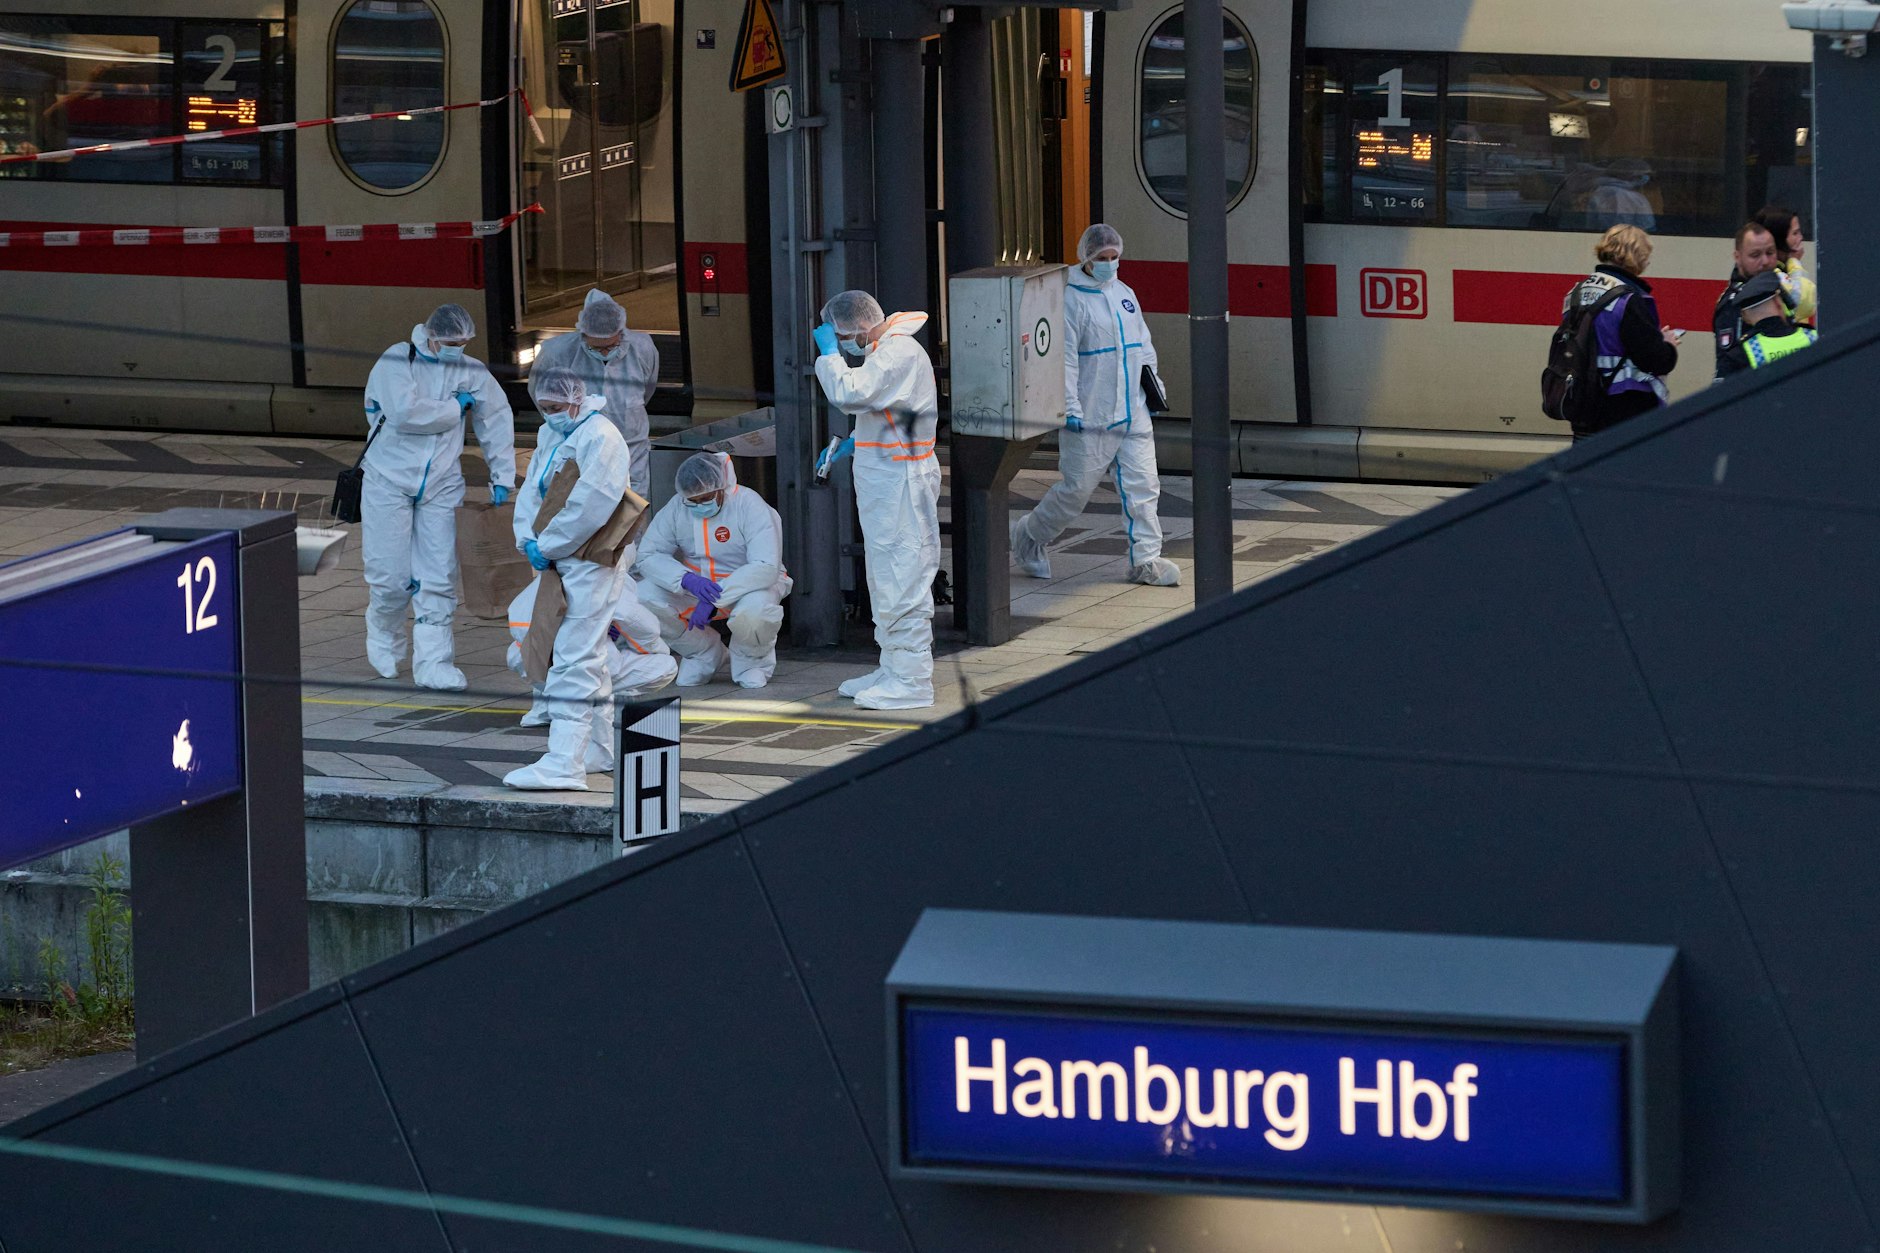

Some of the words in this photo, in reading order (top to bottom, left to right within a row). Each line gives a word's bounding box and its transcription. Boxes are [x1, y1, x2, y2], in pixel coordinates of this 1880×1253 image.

[204, 35, 236, 91] 2
[1378, 68, 1411, 127] 1
[207, 160, 218, 169] 61
[232, 160, 249, 170] 108
[1384, 198, 1396, 208] 12
[1411, 198, 1425, 208] 66
[1369, 276, 1419, 310] DB
[177, 556, 218, 634] 12
[636, 751, 667, 834] H
[954, 1036, 1309, 1151] Hamburg
[1338, 1056, 1478, 1142] Hbf
